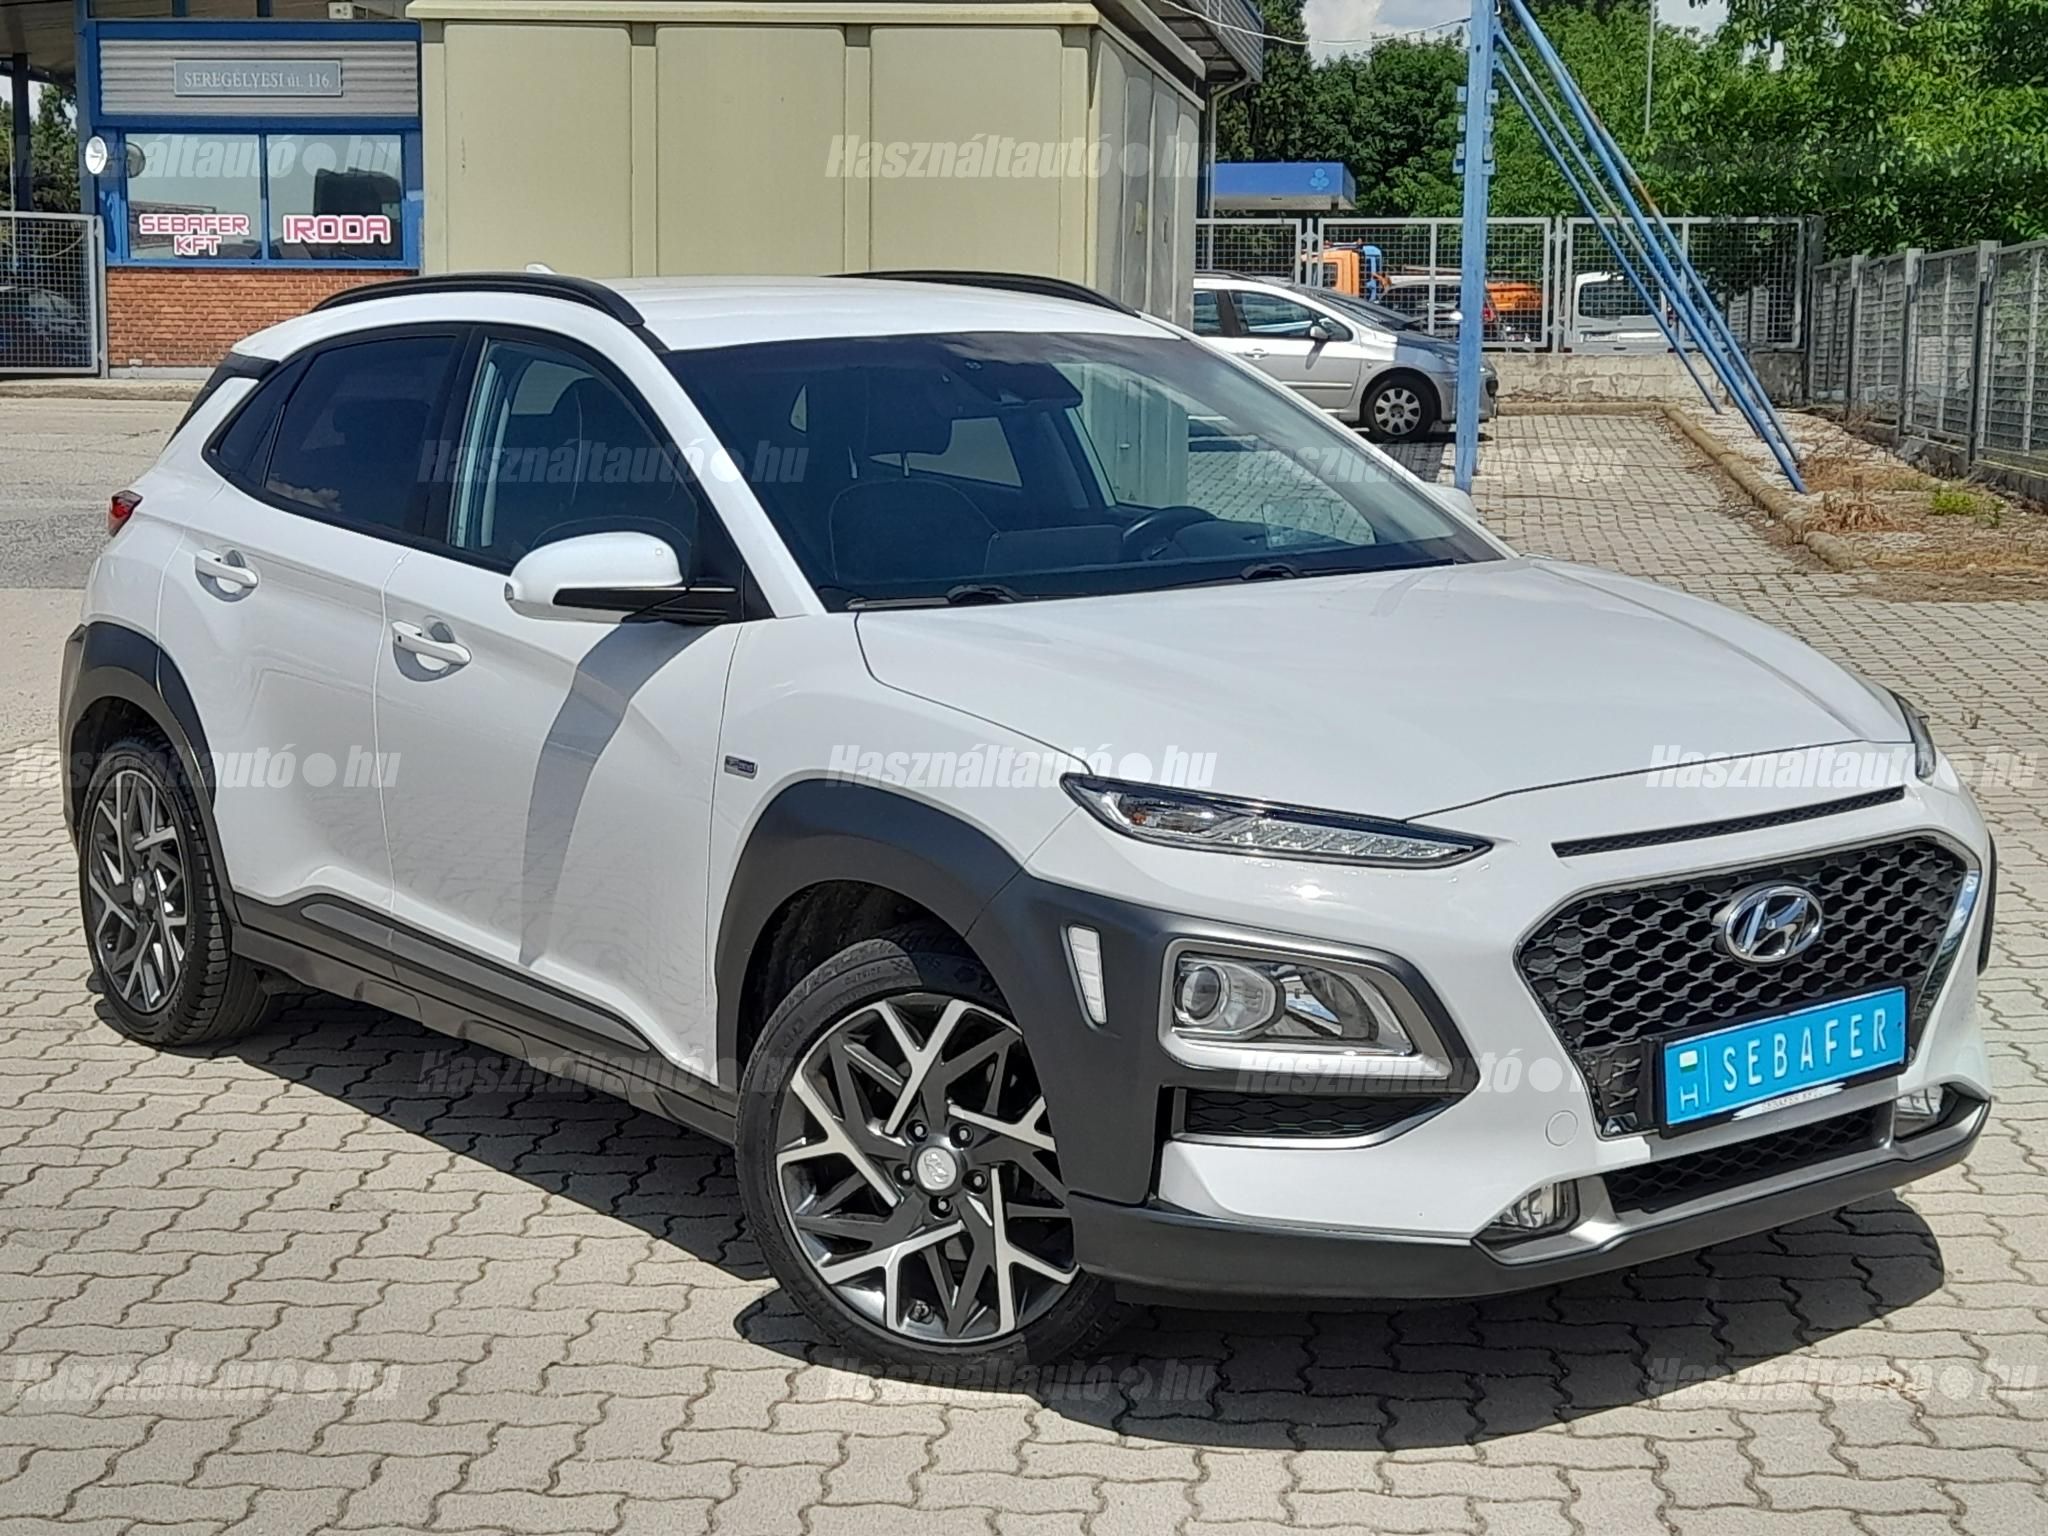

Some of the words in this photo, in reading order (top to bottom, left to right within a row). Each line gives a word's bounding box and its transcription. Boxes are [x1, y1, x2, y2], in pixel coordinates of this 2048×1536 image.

[139, 214, 249, 234] SEBAFER
[283, 214, 391, 243] IRODA
[174, 234, 222, 255] KFT
[1723, 1008, 1887, 1092] SEBAFER
